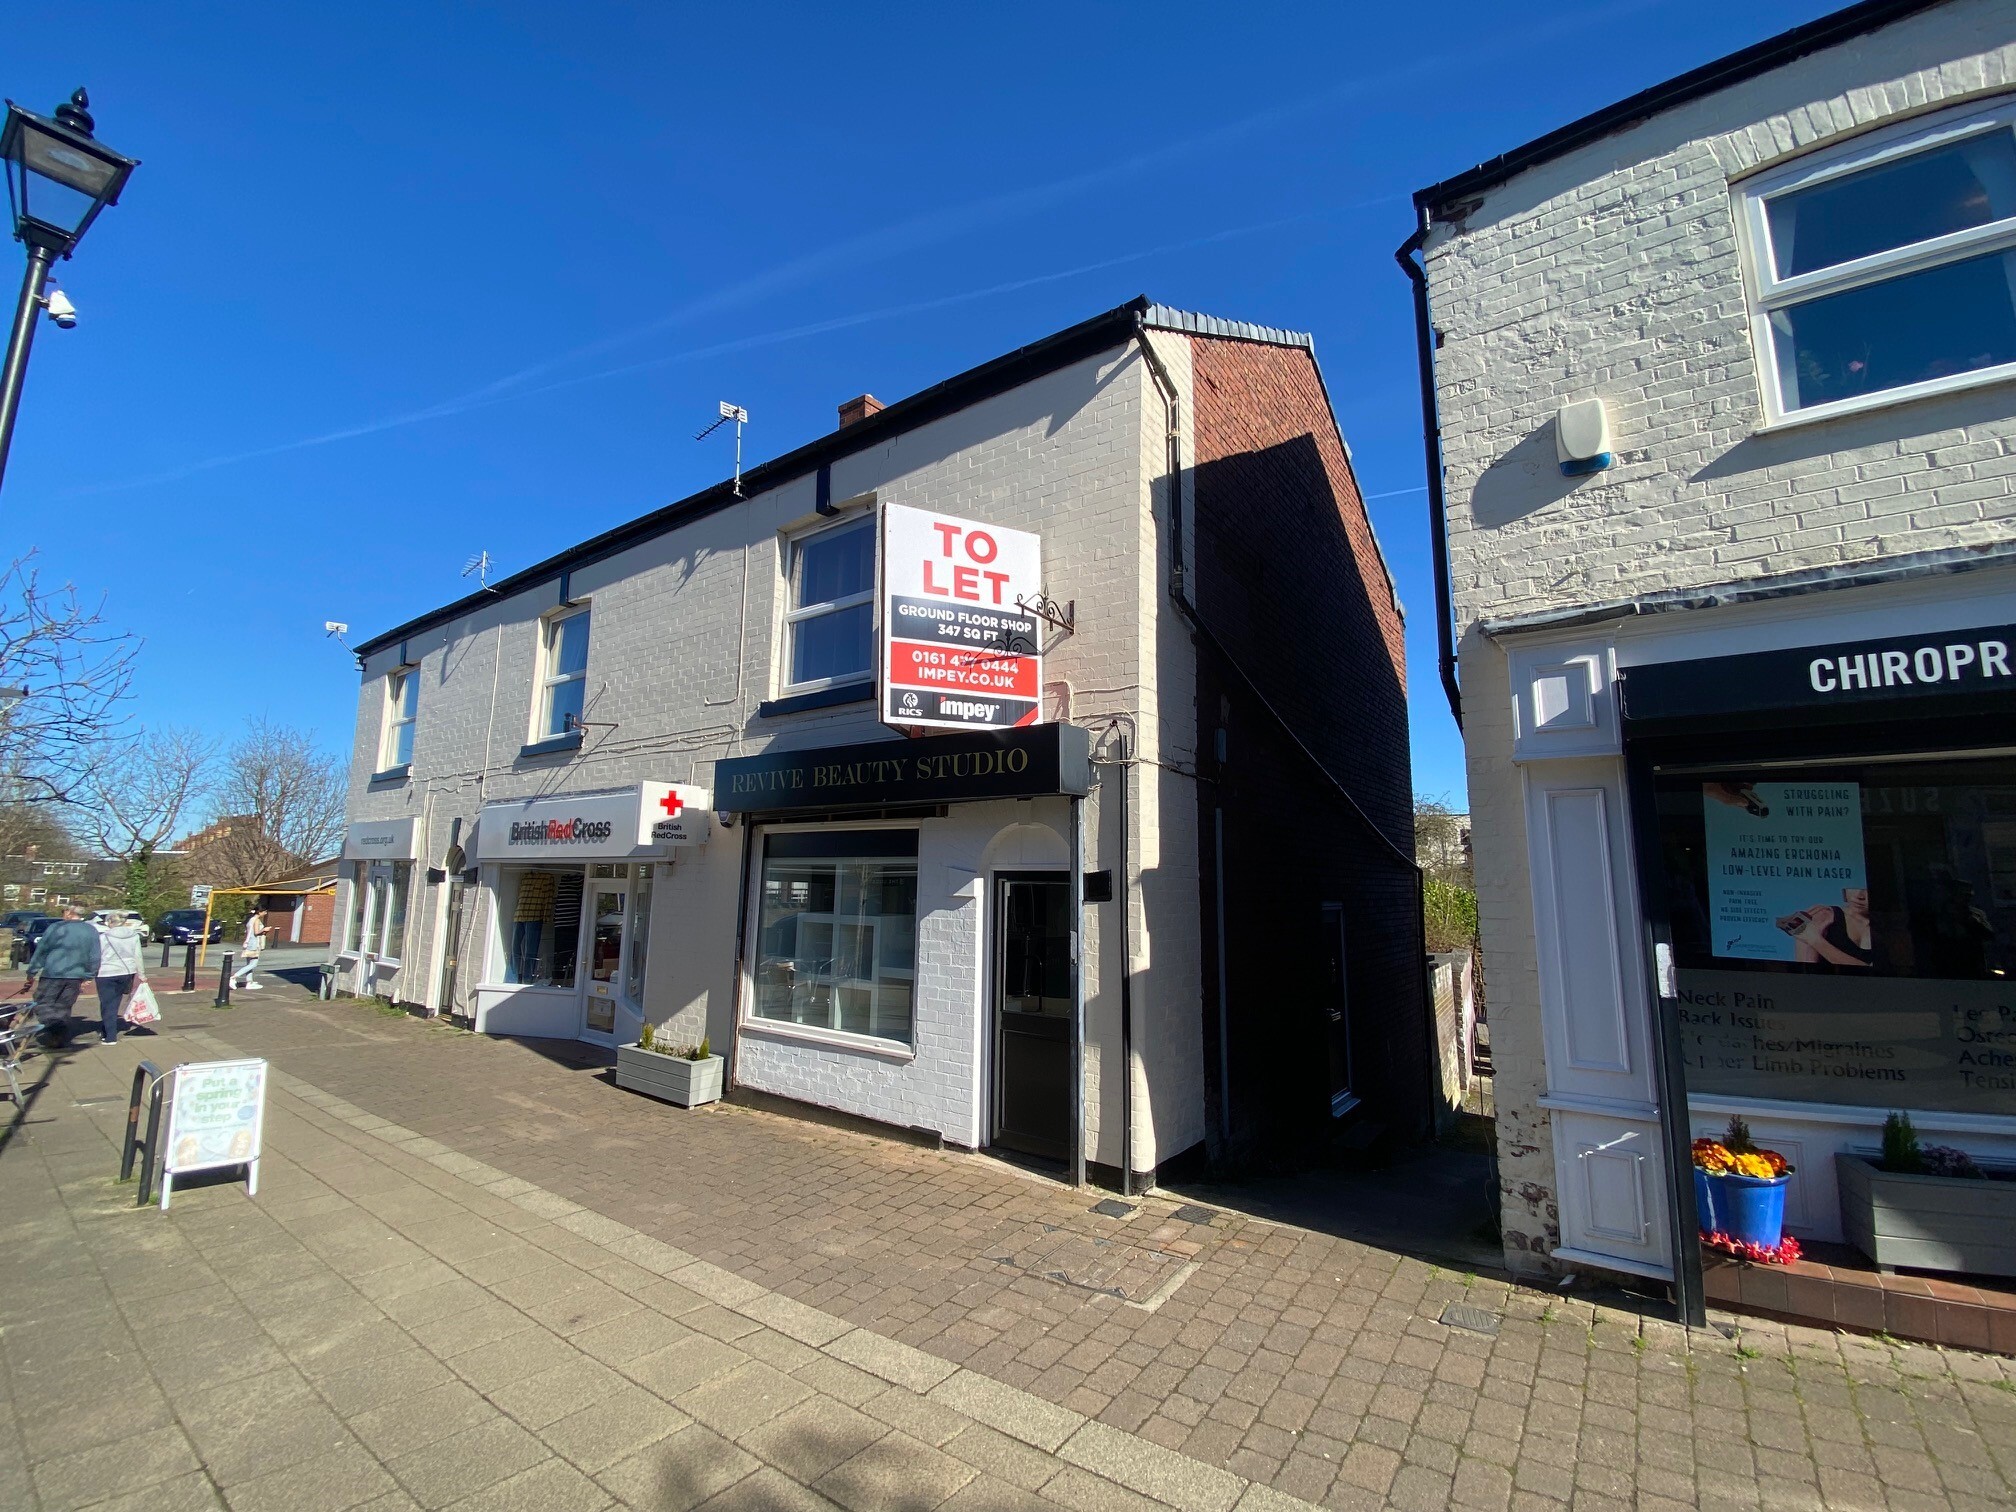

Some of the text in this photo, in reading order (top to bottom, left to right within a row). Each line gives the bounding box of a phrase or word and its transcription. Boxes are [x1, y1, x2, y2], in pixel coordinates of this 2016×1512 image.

[933, 522, 998, 564] TO
[923, 560, 1010, 605] LET
[898, 604, 1032, 633] GROUND FLOOR SHOP
[938, 624, 998, 641] 347 SQ FT
[911, 650, 946, 665] 0161
[980, 660, 1019, 674] 0444
[1809, 641, 2012, 692] CHIROPR
[918, 666, 1015, 688] IMPEY.CO.UK
[898, 707, 923, 716] RICS
[940, 696, 995, 721] impey
[731, 748, 1029, 793] REVIVE BEAUTY STUDIO
[1783, 789, 1849, 800] STRUGGLING
[1786, 806, 1850, 817] WITH PAIN?
[510, 817, 612, 842] BritishRedCross
[657, 822, 683, 831] British
[360, 834, 395, 846] redcross.org.uk
[651, 831, 688, 840] RedCross
[1739, 834, 1824, 844] IT'S TIME TO TRY OUR
[1730, 847, 1841, 860] AMAZING ERCHONIA
[1722, 864, 1852, 879] LOW-LEVEL PAIN LASER
[1677, 989, 1776, 1009] Neck Pain
[1953, 1004, 1984, 1021] Le
[1731, 1012, 1787, 1031] Issues
[1958, 1049, 2016, 1067] Ache
[1753, 1056, 1802, 1074] Limb
[1809, 1058, 1906, 1082] Problems
[202, 1078, 238, 1088] Put a
[196, 1088, 242, 1102] spring
[194, 1103, 207, 1113] in
[209, 1101, 241, 1113] your
[200, 1113, 232, 1124] step
